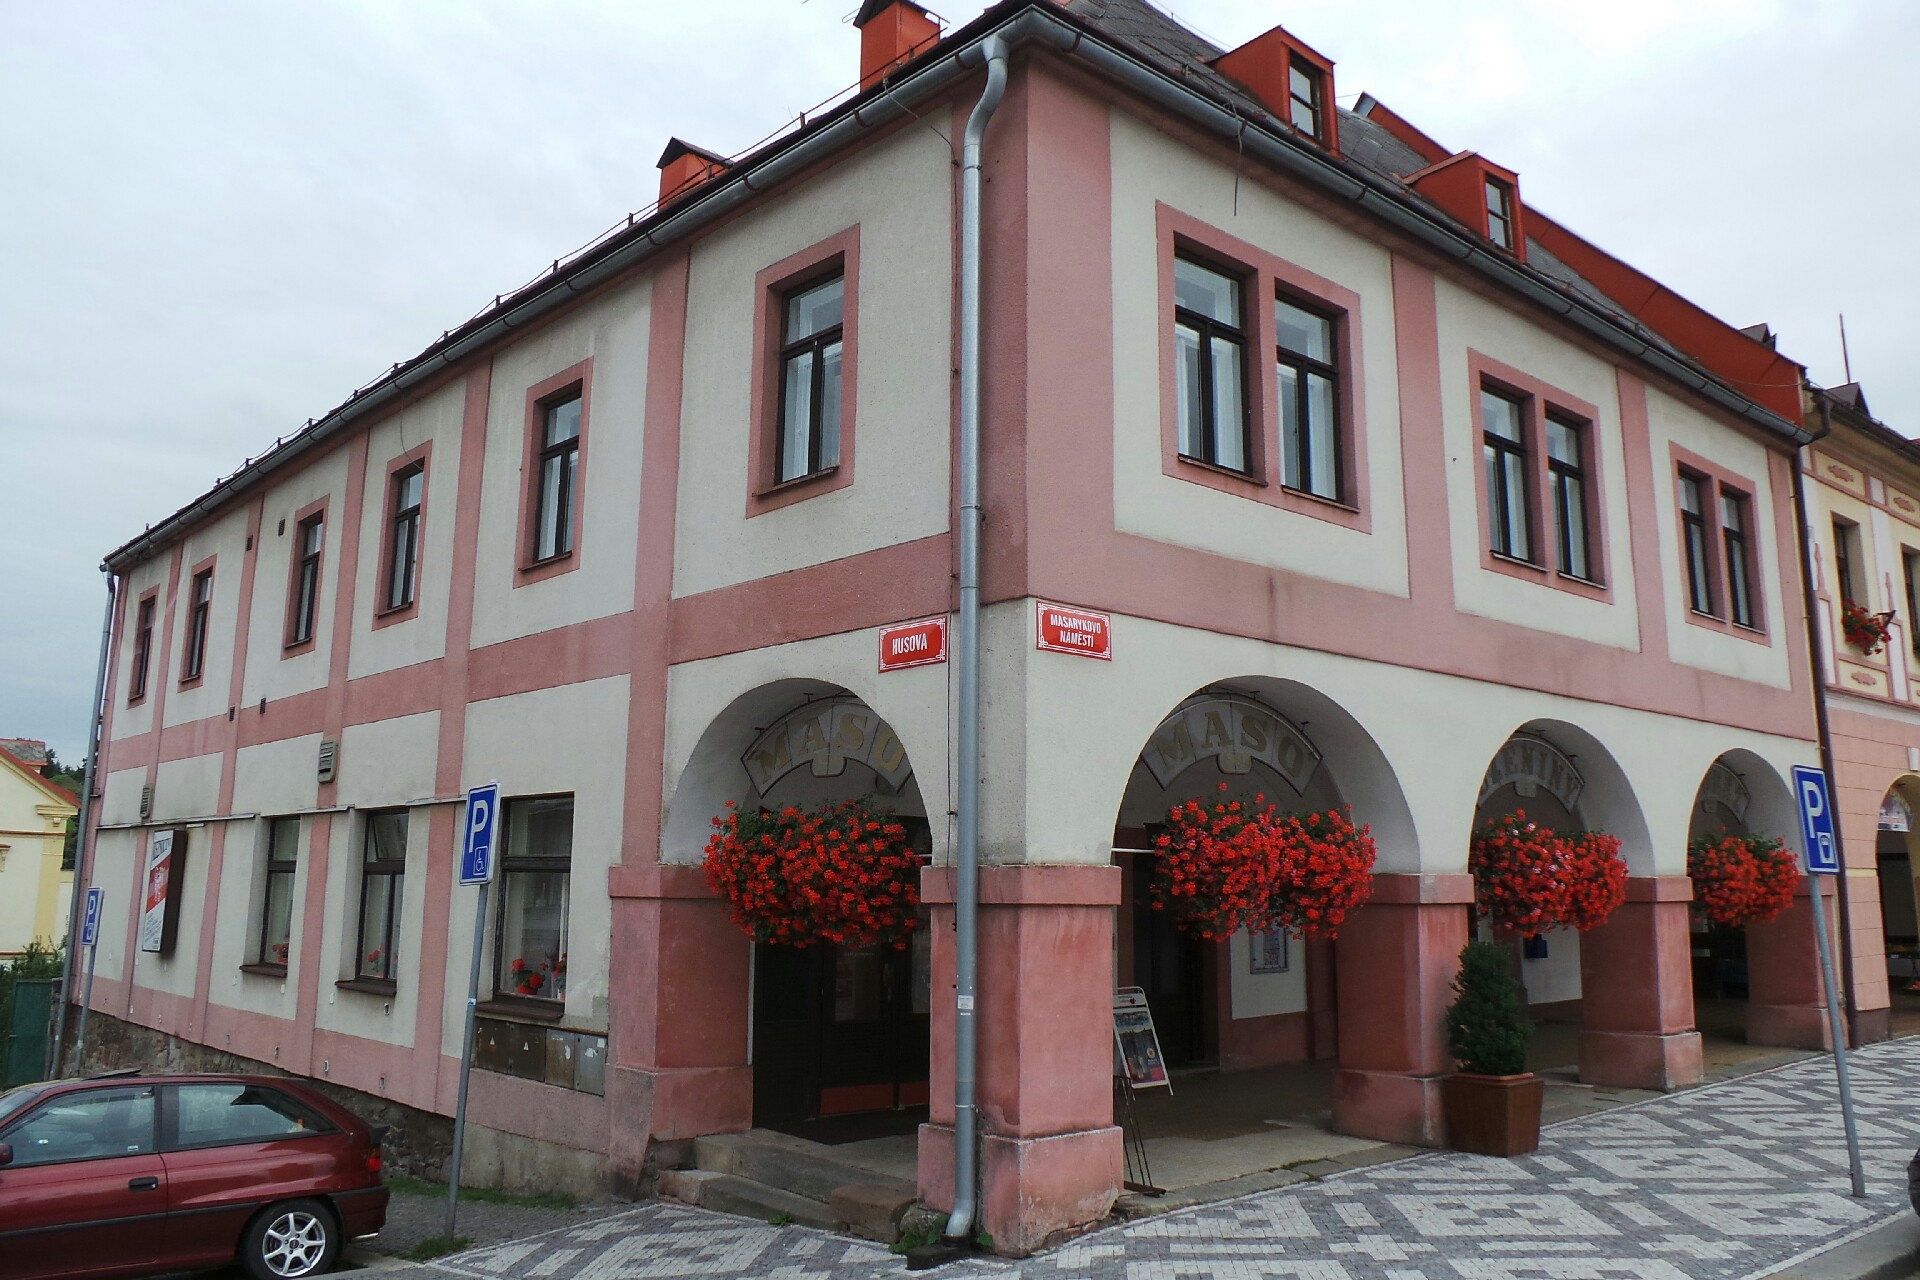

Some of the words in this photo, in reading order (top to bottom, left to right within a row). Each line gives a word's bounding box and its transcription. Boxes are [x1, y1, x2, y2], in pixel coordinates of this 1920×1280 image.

[892, 632, 928, 656] HUSOVA
[1050, 613, 1102, 634] MASARYKOVO
[1059, 629, 1095, 648] NÁMĚSTÍ
[747, 714, 905, 782] MASO
[1151, 710, 1305, 778] MASO
[469, 800, 488, 852] P
[1802, 781, 1823, 838] P
